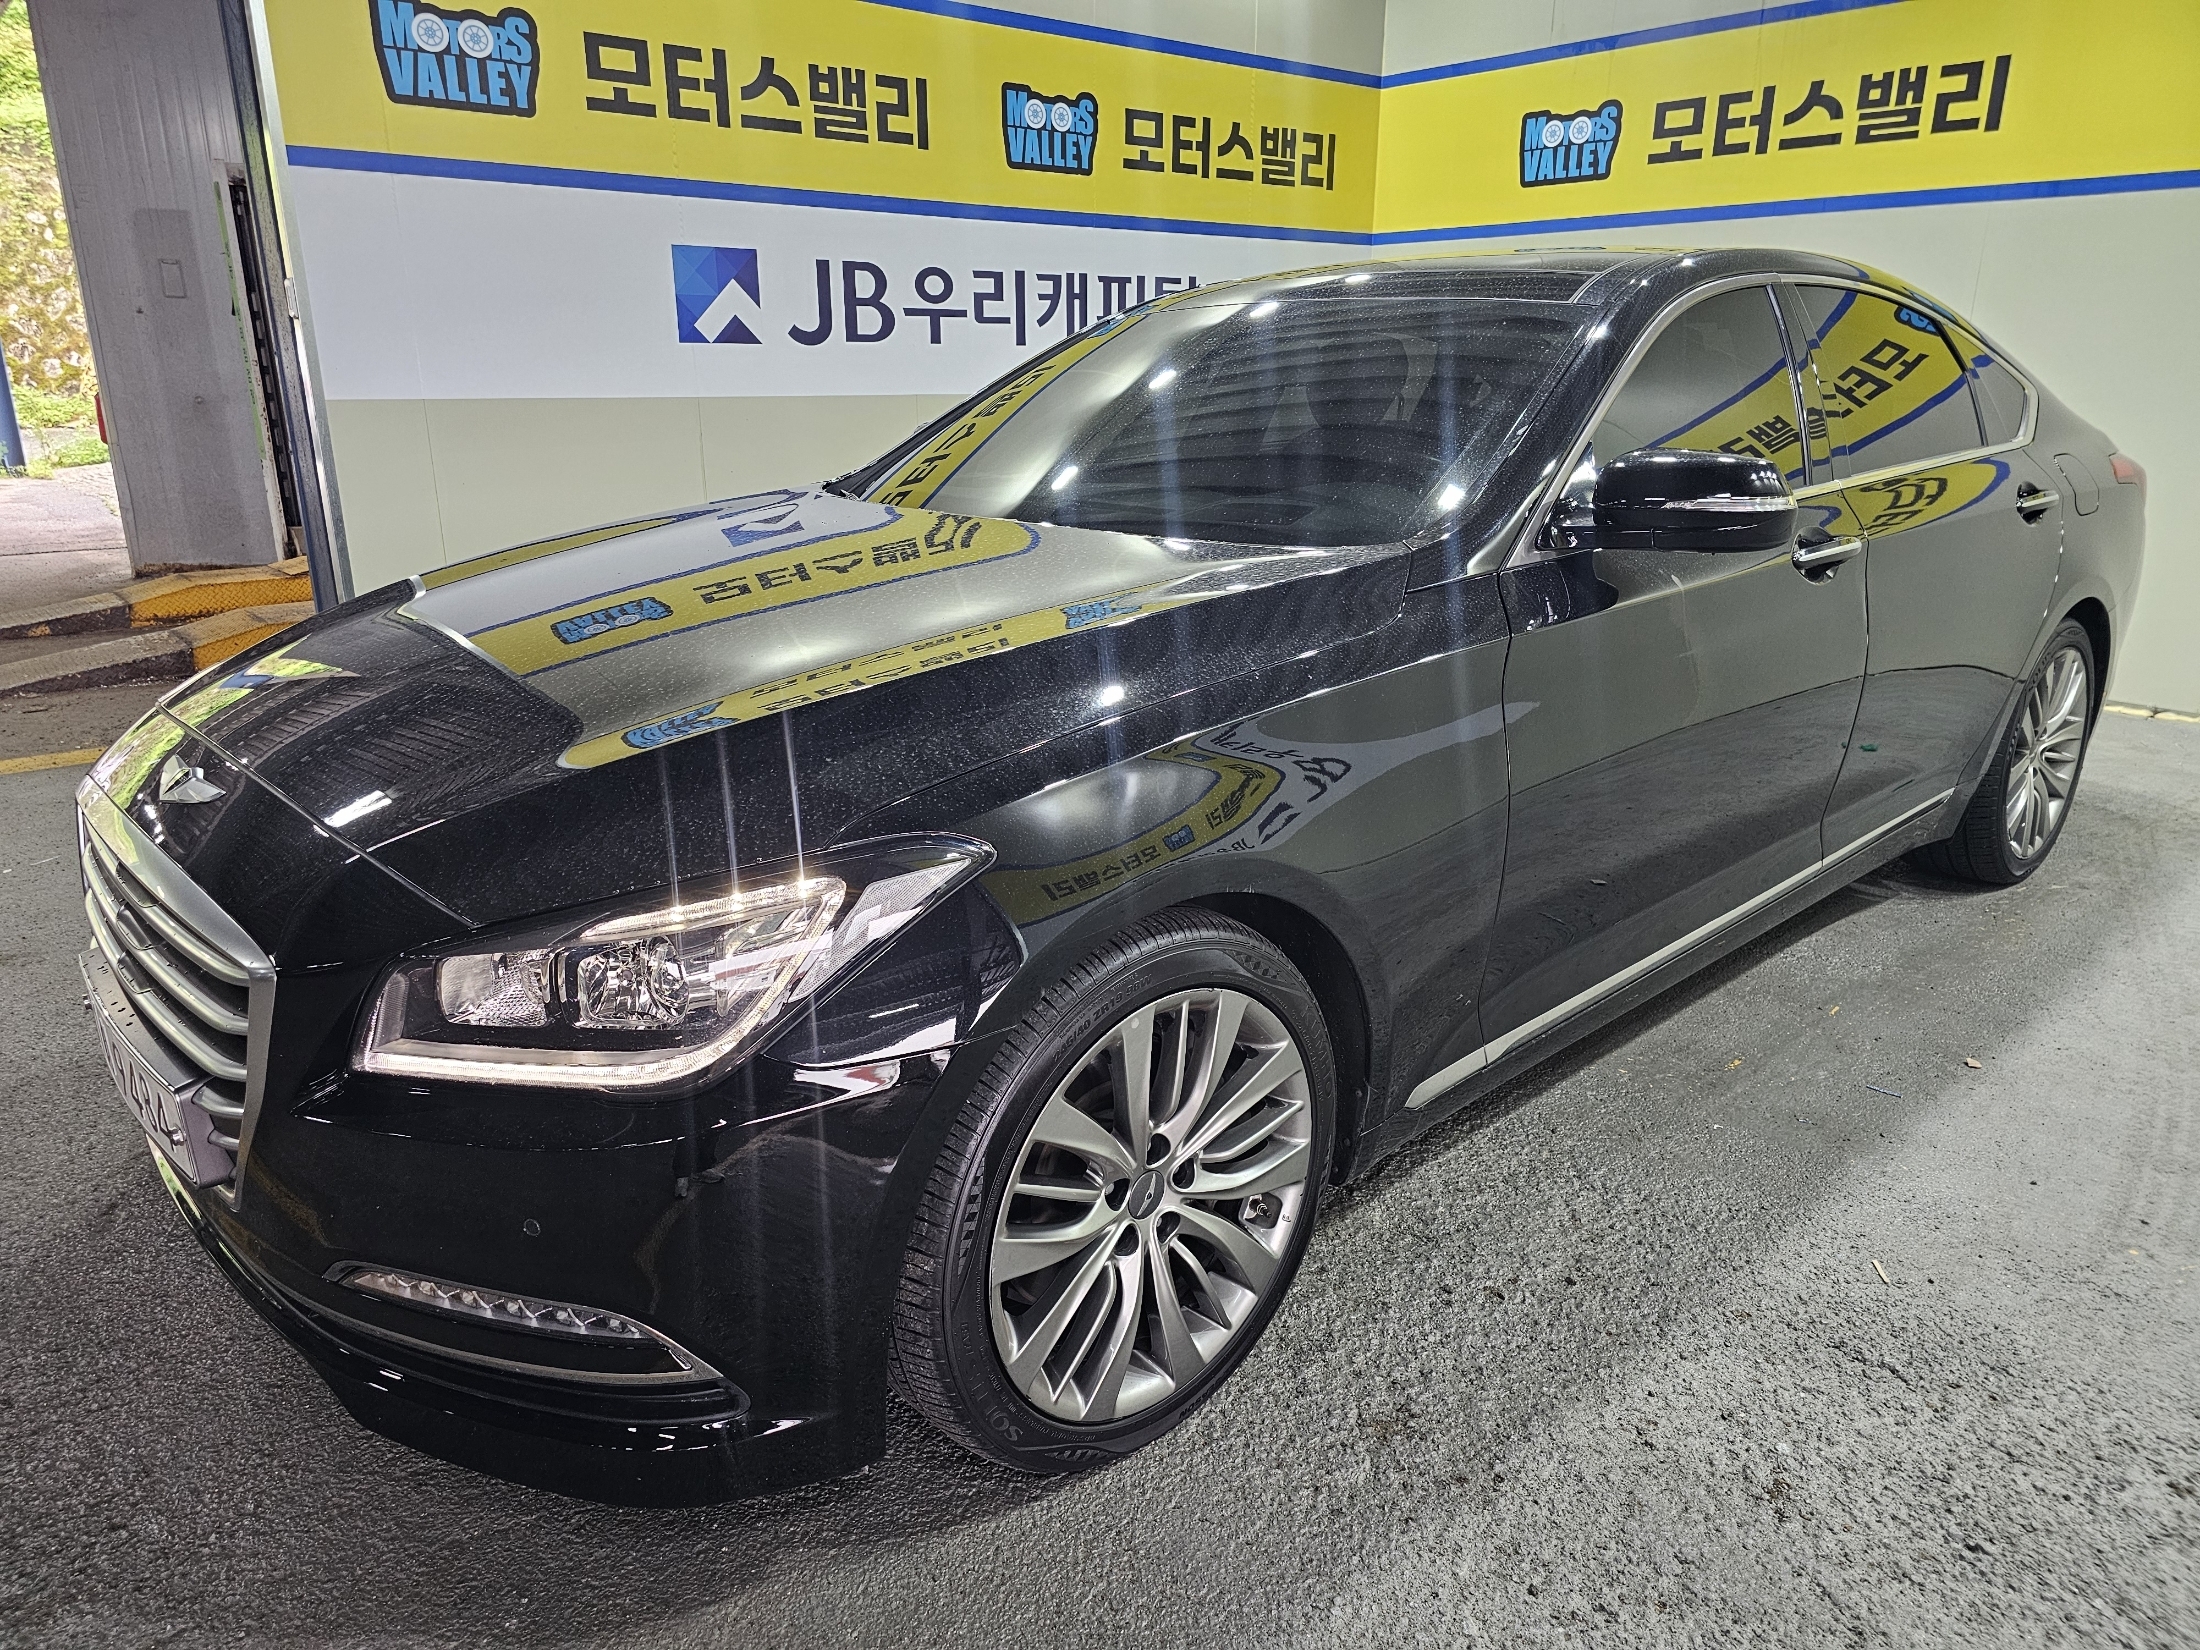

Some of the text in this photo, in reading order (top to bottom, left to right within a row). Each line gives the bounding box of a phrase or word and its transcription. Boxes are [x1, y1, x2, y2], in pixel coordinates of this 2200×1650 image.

[383, 47, 532, 109] VALLEY
[583, 31, 929, 150] 모터스밸리
[1647, 54, 2012, 164] 모터스밸리
[1008, 127, 1093, 170] VALLEY
[1122, 108, 1336, 190] 모터스밸리
[1523, 133, 1612, 182] VALLEY
